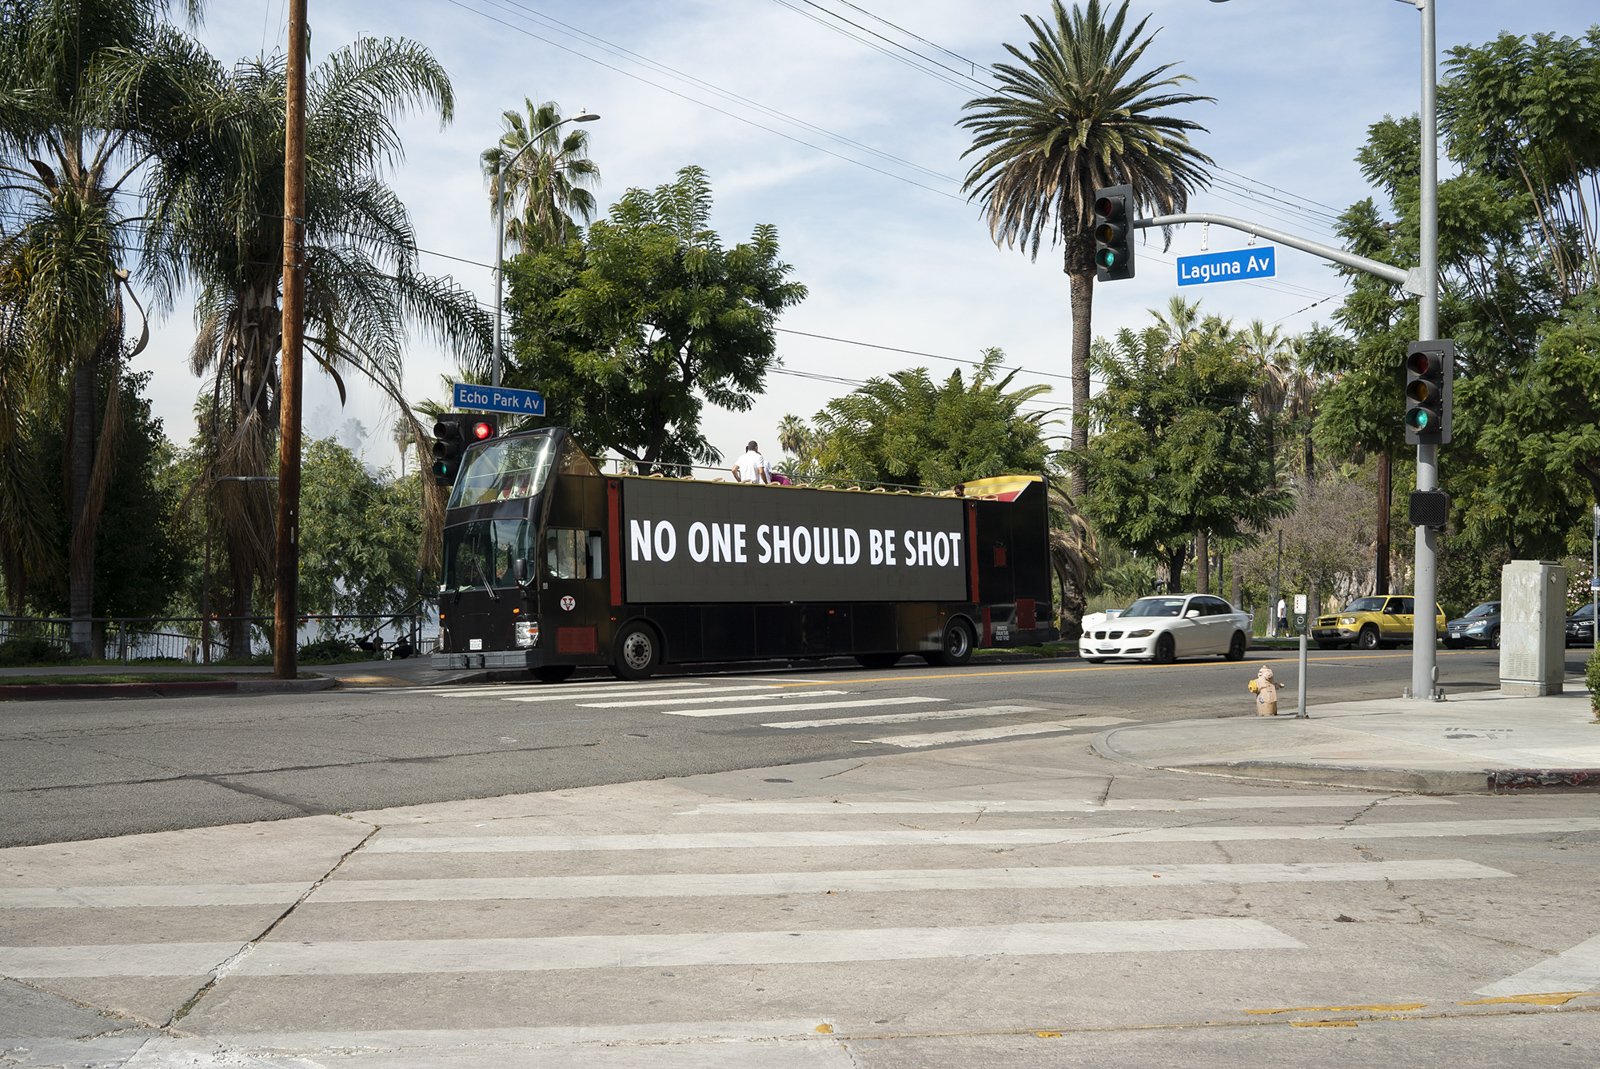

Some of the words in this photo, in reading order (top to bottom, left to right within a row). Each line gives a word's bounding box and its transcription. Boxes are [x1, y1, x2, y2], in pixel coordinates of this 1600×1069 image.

[1182, 261, 1240, 282] Laguna
[1246, 255, 1270, 273] Av
[459, 389, 488, 405] Echo
[493, 393, 519, 408] Park
[524, 396, 540, 410] Av
[630, 519, 677, 562] NO
[688, 521, 747, 562] ONE
[756, 524, 861, 565] SHOULD
[869, 529, 897, 565] BE
[903, 530, 962, 567] SHOT
